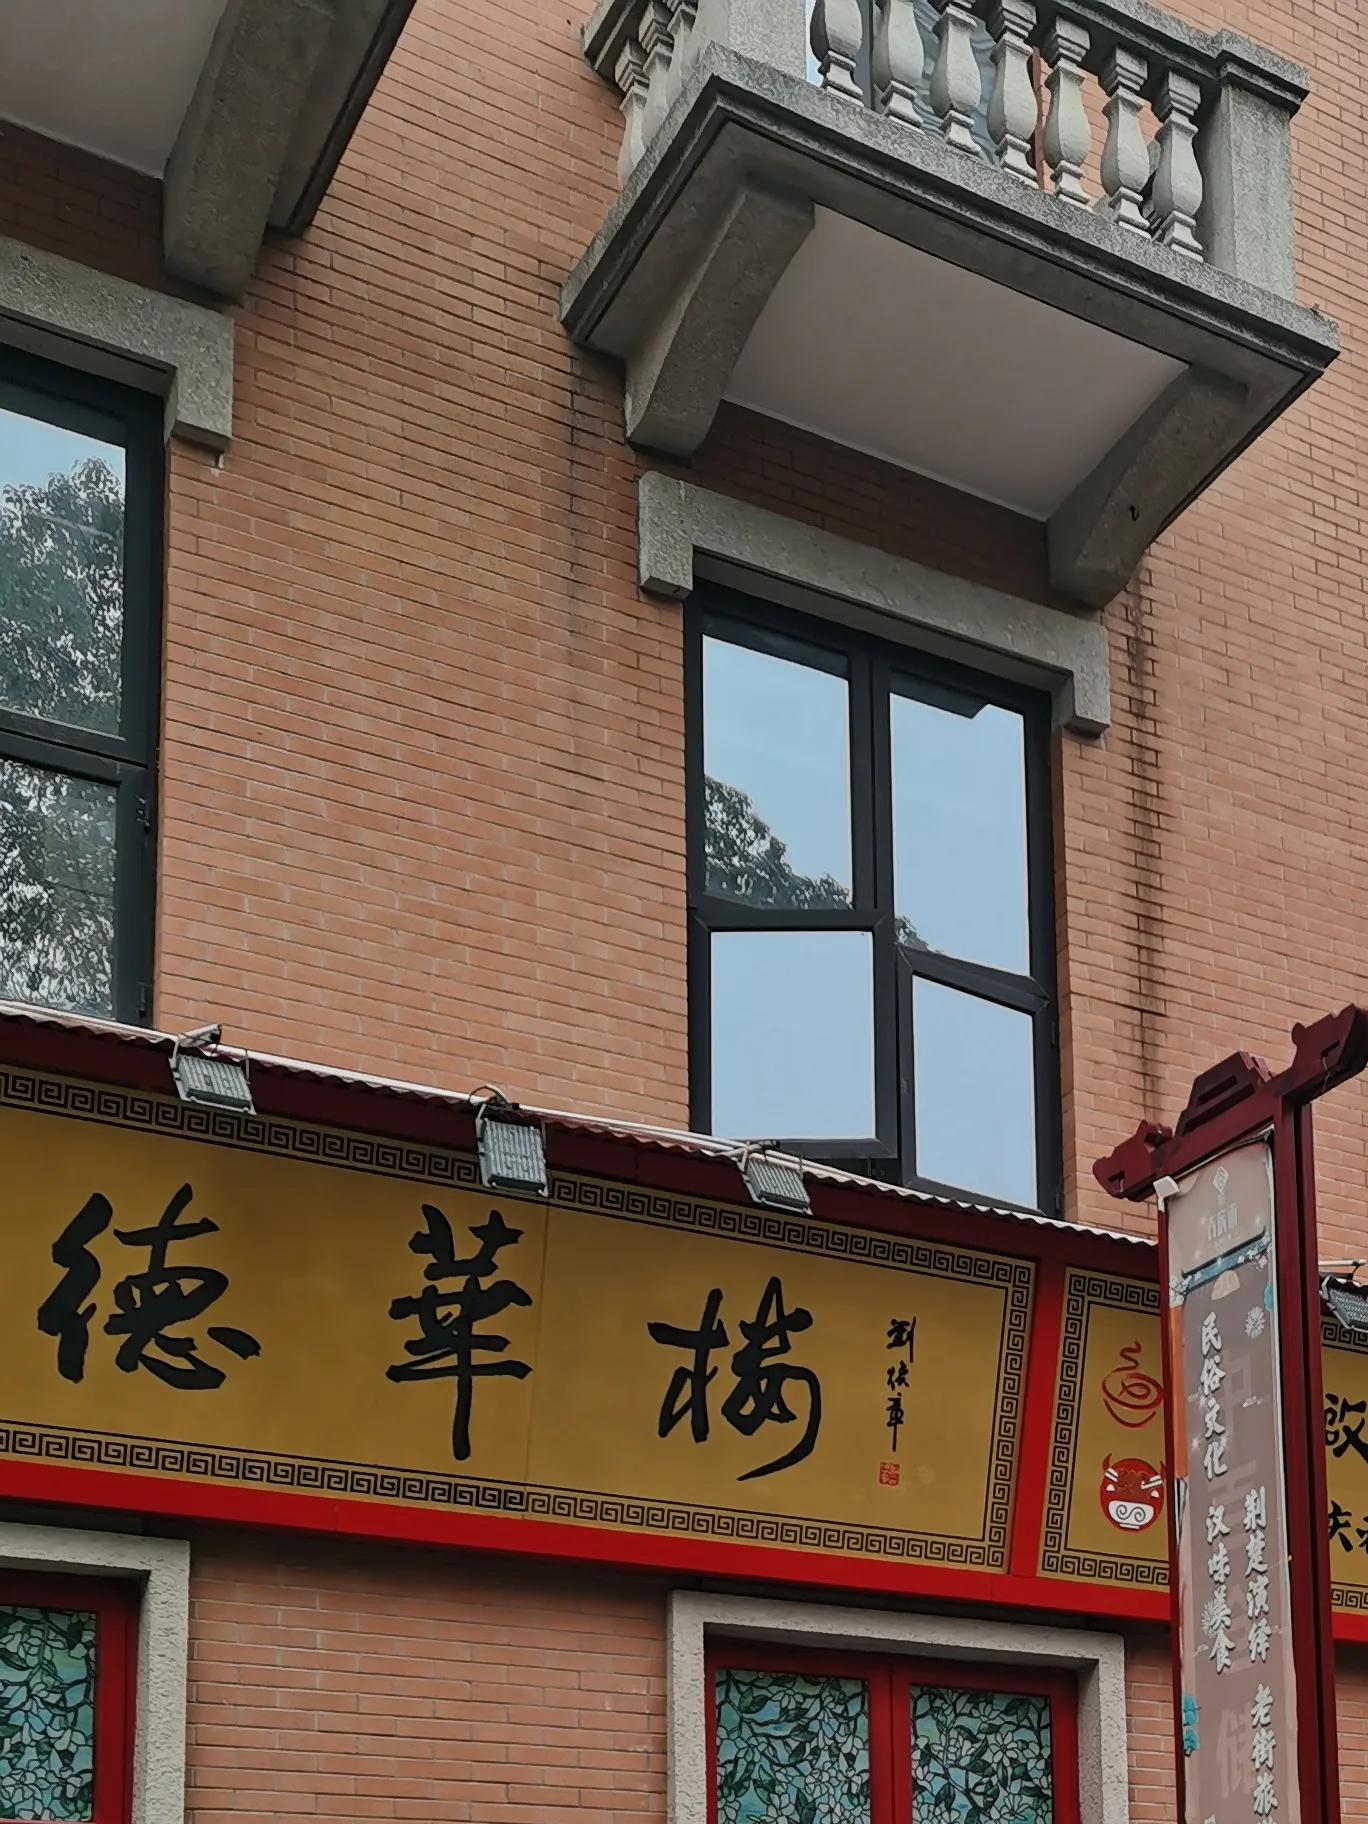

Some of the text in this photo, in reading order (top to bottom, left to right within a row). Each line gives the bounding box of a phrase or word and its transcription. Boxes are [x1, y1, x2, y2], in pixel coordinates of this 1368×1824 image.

[1200, 1312, 1236, 1674] 民俗文化 汉味美食
[1243, 1486, 1273, 1663] 荆楚演绎
